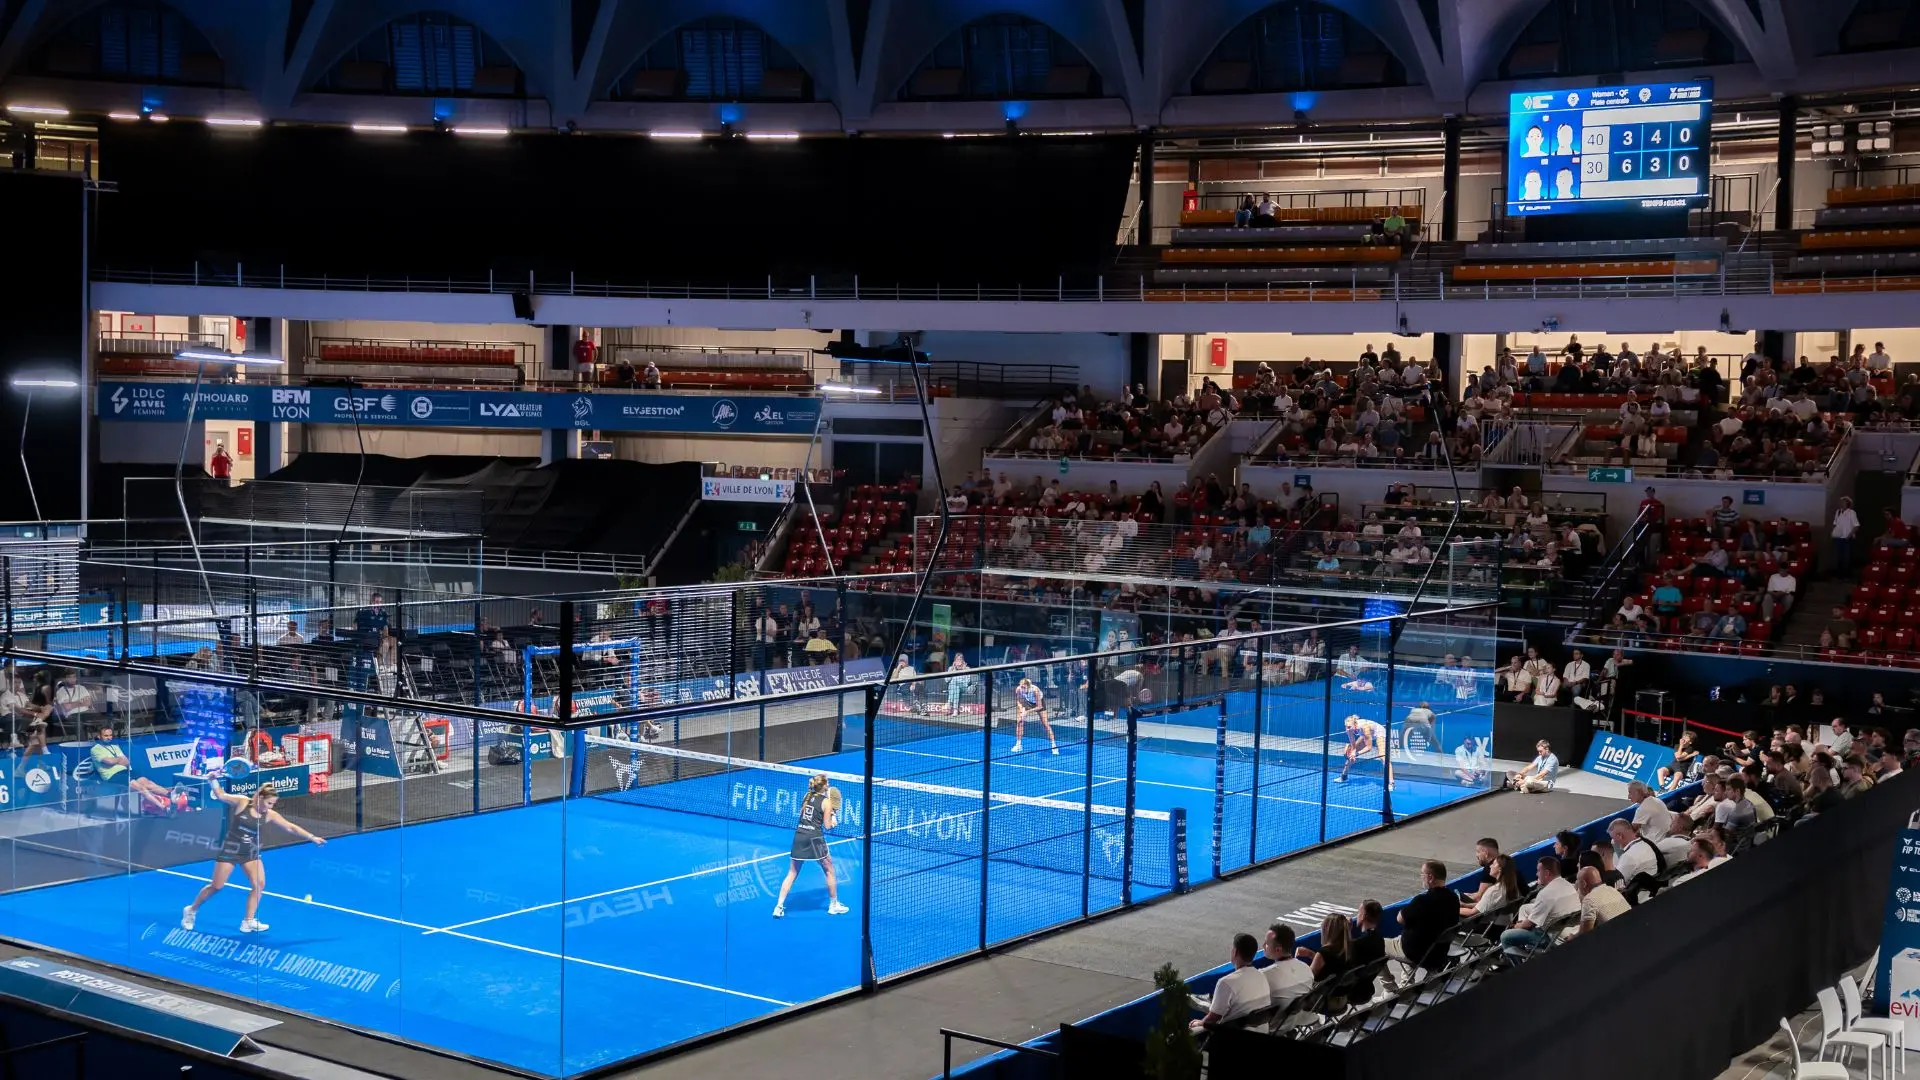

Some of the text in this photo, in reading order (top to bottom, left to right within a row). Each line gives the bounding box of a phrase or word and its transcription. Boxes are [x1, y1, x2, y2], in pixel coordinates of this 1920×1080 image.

[1586, 127, 1691, 146] 40 3 4 0
[1586, 155, 1690, 174] 30 6 3 0
[132, 388, 165, 399] LDLC
[272, 389, 311, 404] BFM
[133, 400, 166, 408] ASVEL
[333, 397, 379, 411] GSF
[480, 402, 521, 416] LYA
[272, 406, 310, 419] LYON
[722, 485, 774, 495] VILLE DE LYON
[790, 669, 823, 680] VILLE DE
[846, 671, 885, 682] CUPRA
[1599, 737, 1645, 771] inelys
[231, 783, 257, 793] Région
[272, 776, 299, 789] inelys
[733, 782, 768, 812] FIP
[907, 808, 972, 842] LYON
